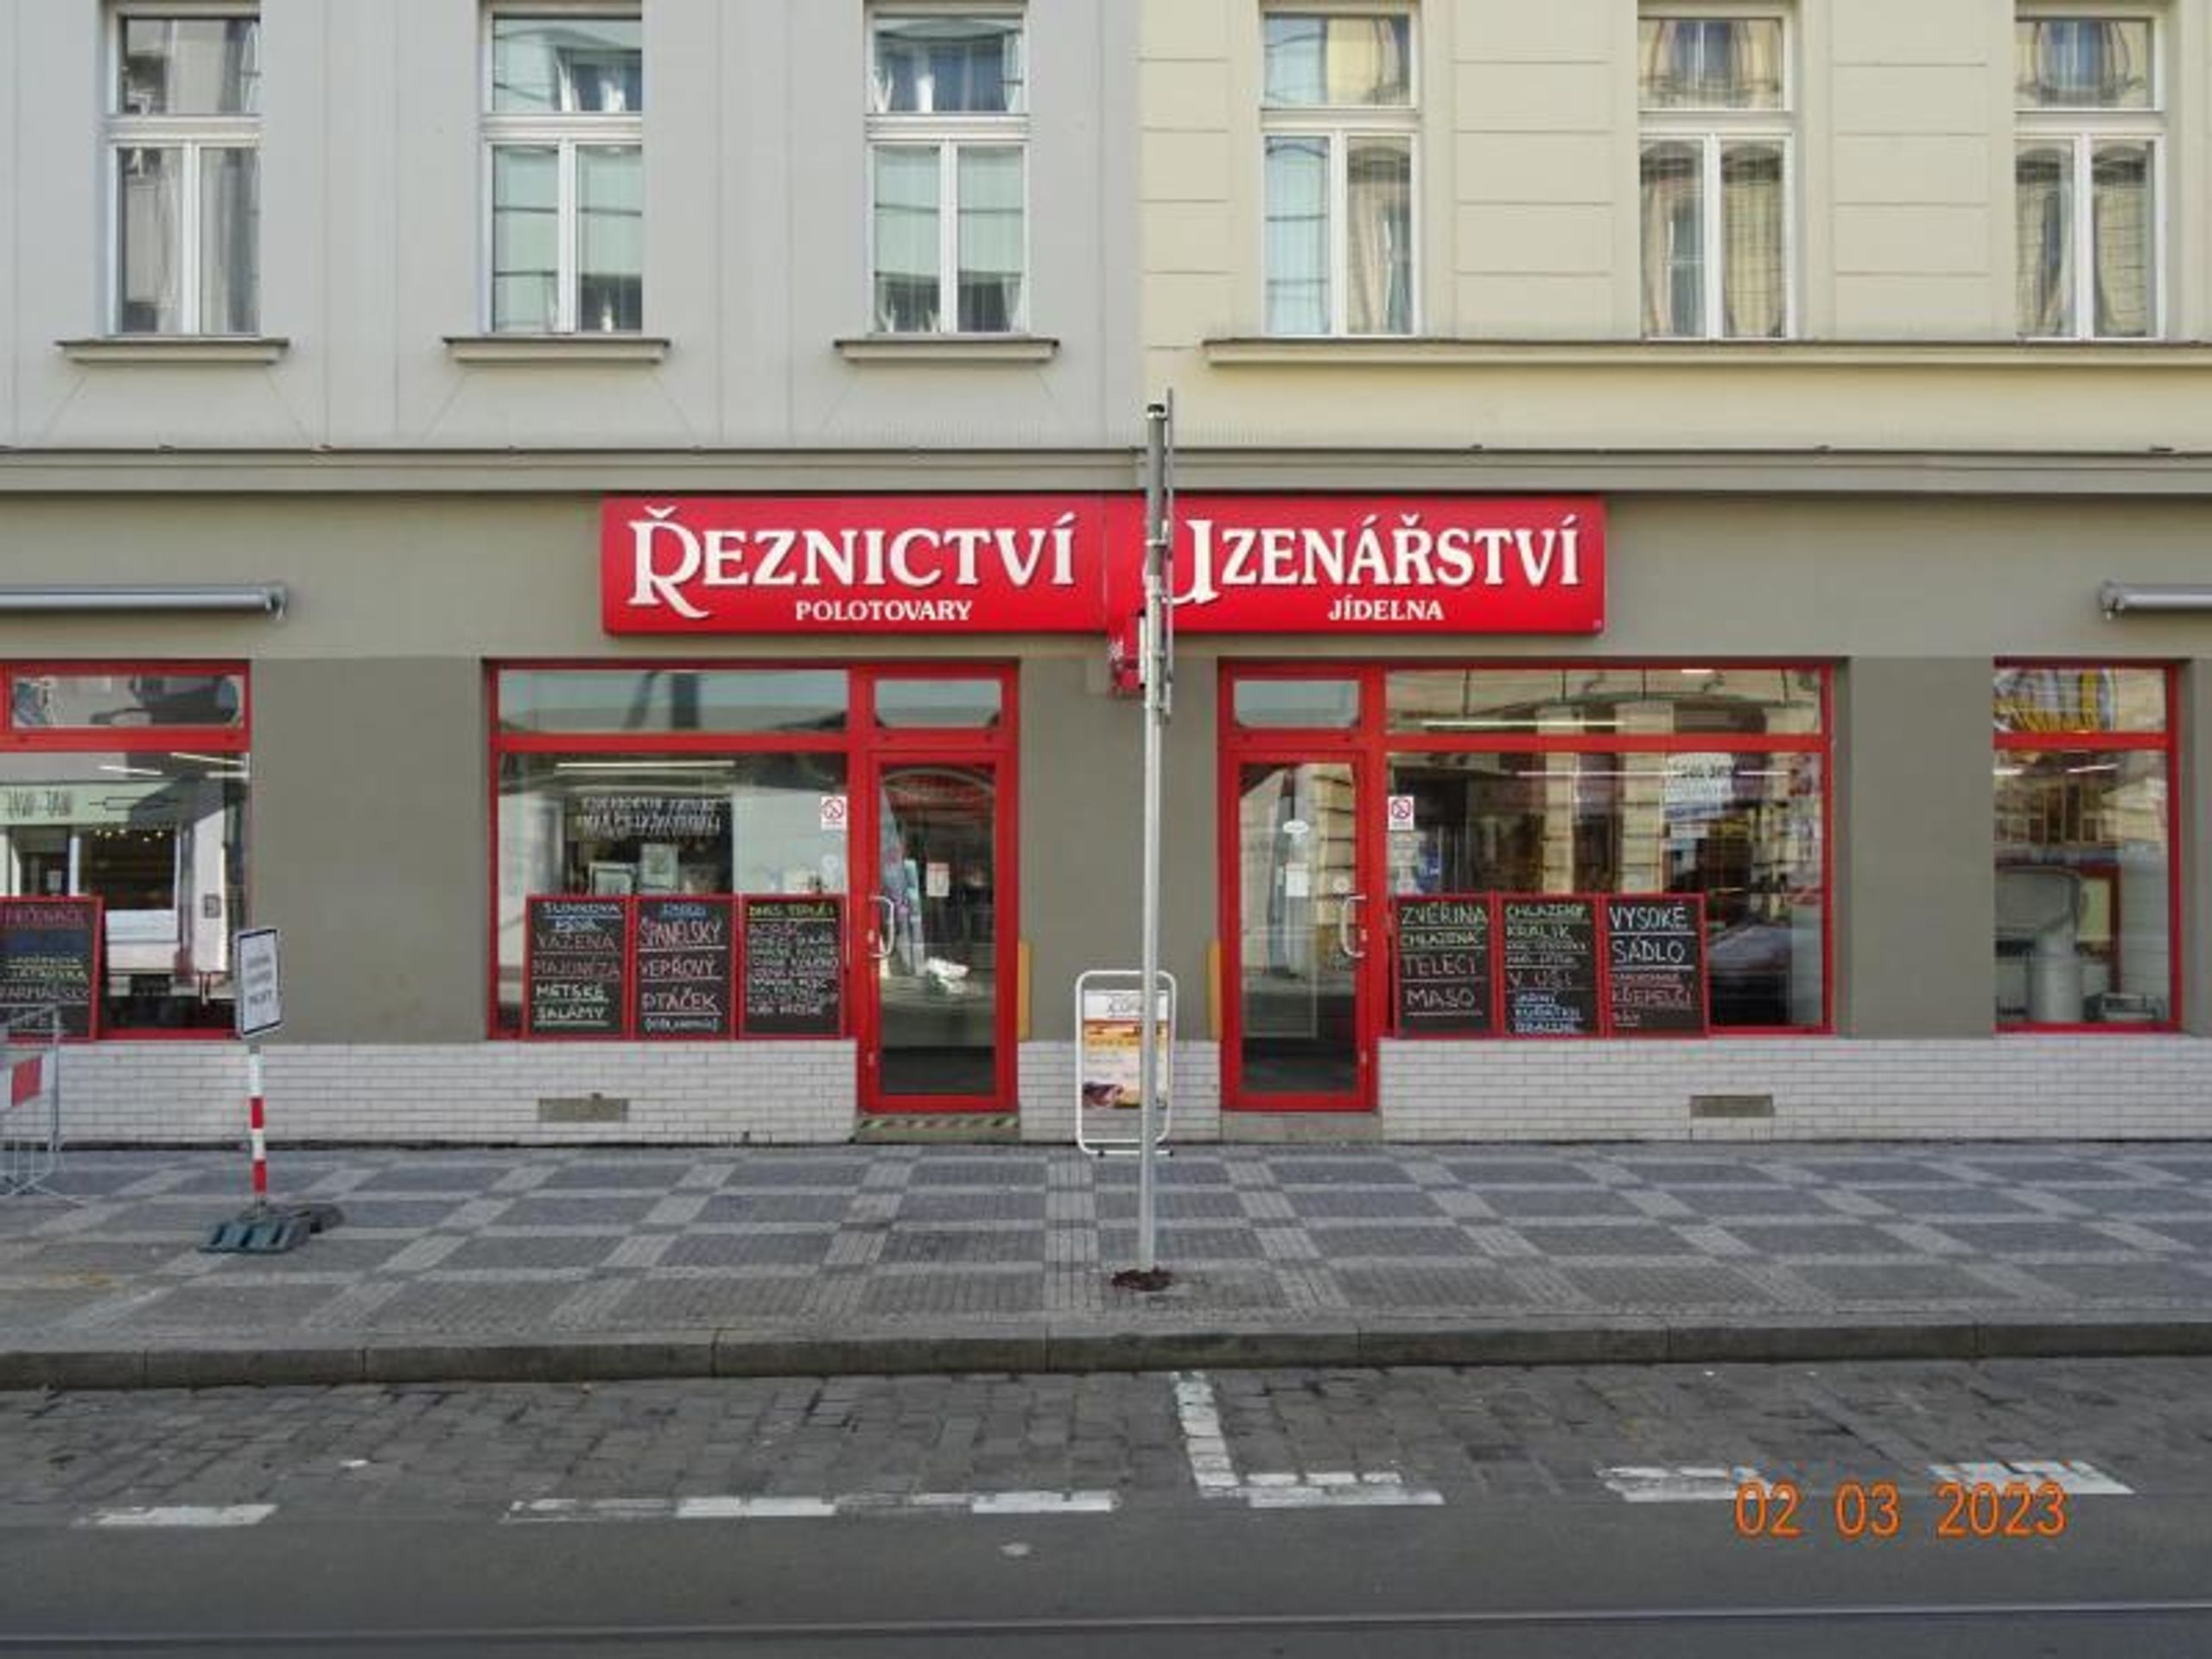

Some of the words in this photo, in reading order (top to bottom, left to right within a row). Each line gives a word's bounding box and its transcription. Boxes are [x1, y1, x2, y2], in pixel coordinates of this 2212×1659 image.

[628, 505, 1077, 619] ŘEZNICTVÍ
[795, 600, 973, 621] POLOTOVARY
[1327, 594, 1446, 621] JÍDELNA
[1608, 901, 1688, 931] VYSOKÉ
[1611, 935, 1686, 964] SÁDLO
[1406, 986, 1476, 1009] MASO
